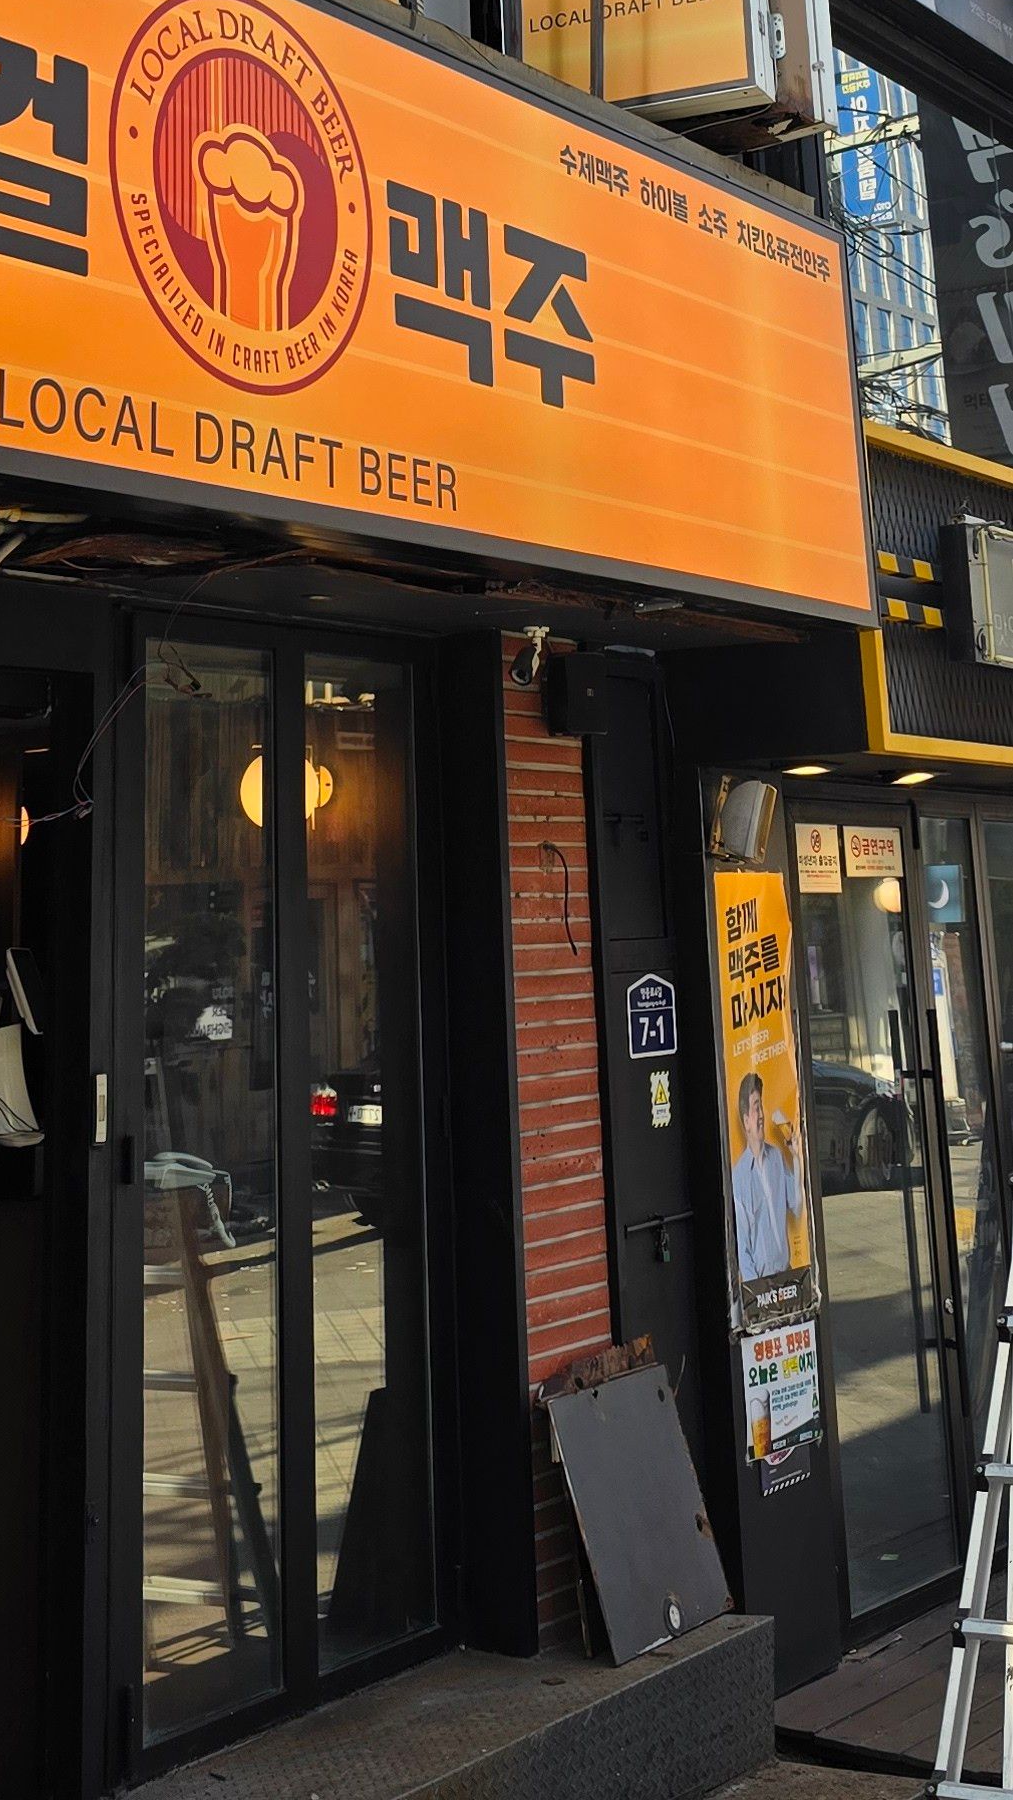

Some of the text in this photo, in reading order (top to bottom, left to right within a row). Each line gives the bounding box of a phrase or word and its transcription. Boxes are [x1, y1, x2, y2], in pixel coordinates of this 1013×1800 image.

[529, 6, 592, 33] LOCAL
[130, 8, 355, 185] LOCAL DRAFT BEER
[559, 145, 830, 282] 수제맥주 하이볼 소주 치킨&퓨전안주
[131, 192, 359, 374] SPECIALIZED IN CRAFT BEER IN KOREA
[387, 179, 596, 410] 맥주
[194, 410, 343, 488] DRAFT
[360, 446, 459, 512] BEER
[861, 838, 895, 856] 금연구역
[725, 898, 758, 943] 함께
[728, 933, 779, 983] 맥주를
[639, 1015, 665, 1046] 7-1
[778, 1284, 798, 1302] BEER
[754, 1337, 783, 1362] 영등포
[749, 1362, 778, 1388] 오늘은
